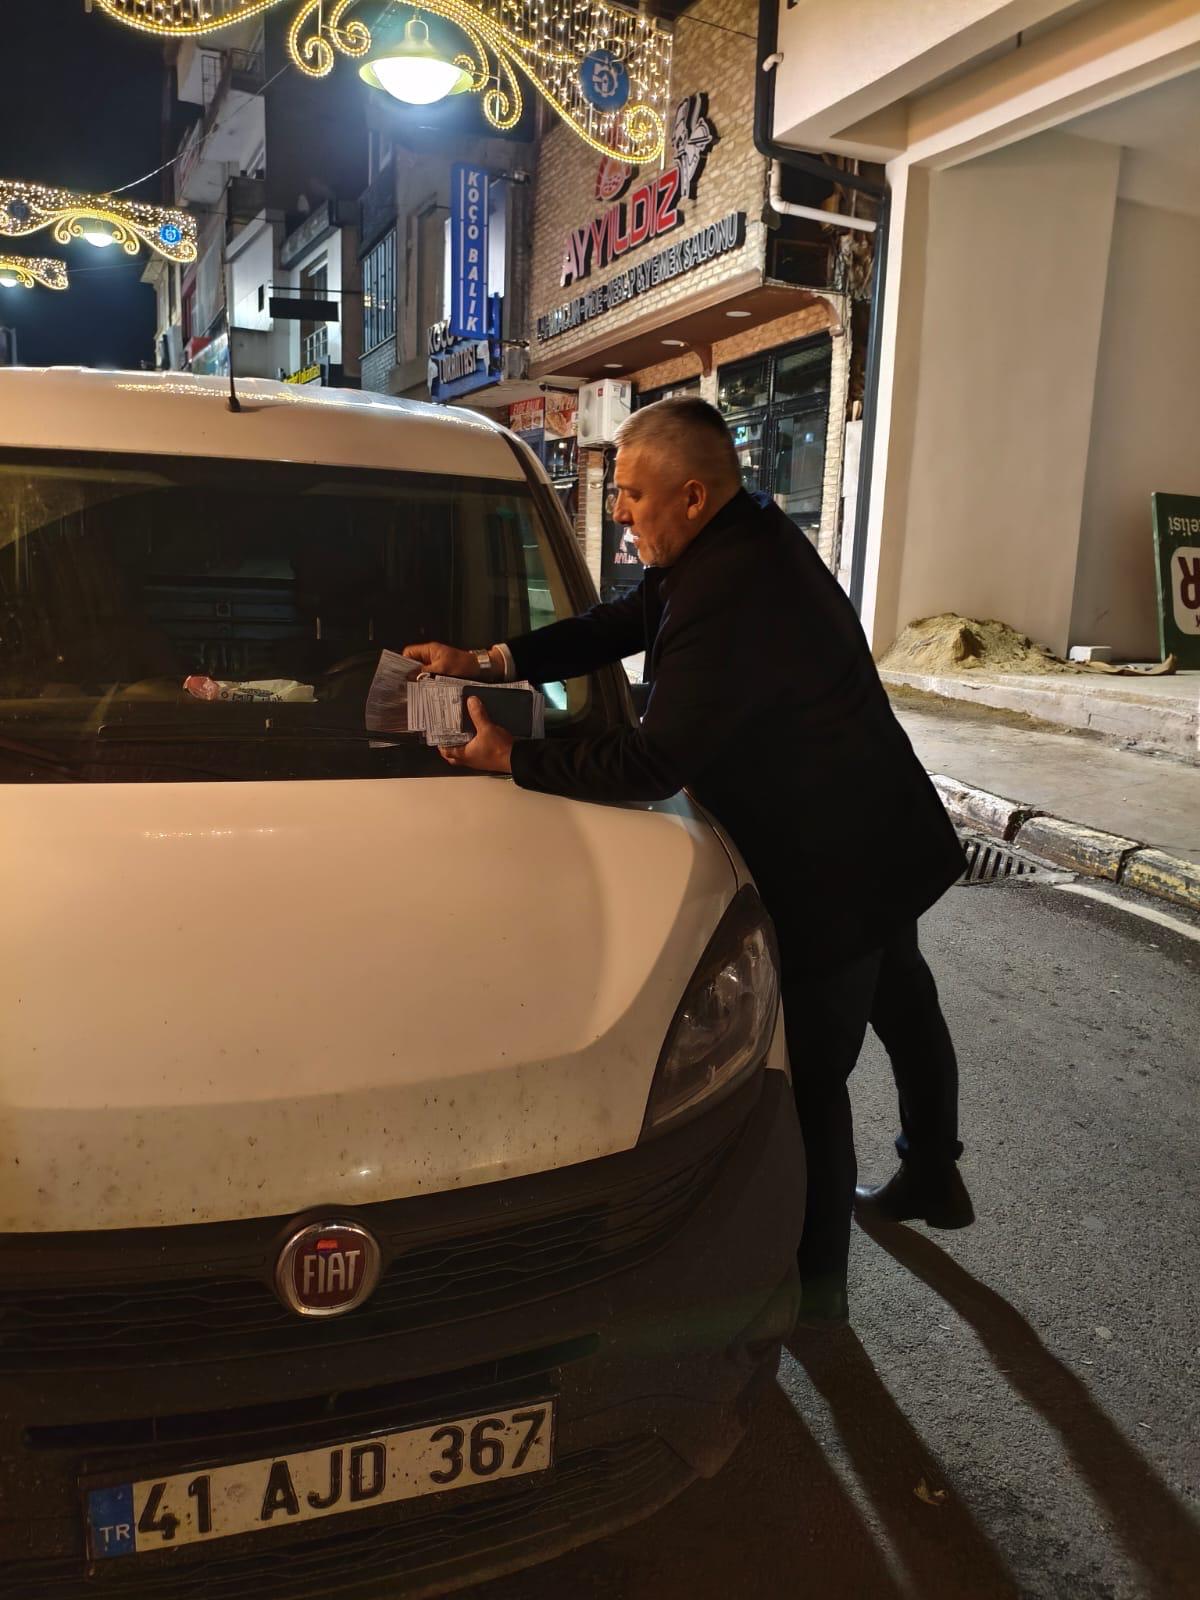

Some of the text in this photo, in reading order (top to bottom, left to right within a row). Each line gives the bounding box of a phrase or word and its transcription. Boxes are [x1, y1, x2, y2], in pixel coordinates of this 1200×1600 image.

[466, 171, 480, 332] KOÇO BALIK
[560, 166, 680, 288] AYYILDIZ
[682, 212, 739, 271] SALONU
[1168, 516, 1200, 537] elisi
[303, 1249, 361, 1295] FIAT
[138, 1408, 547, 1540] 41 AJD 367
[100, 1523, 131, 1543] TR
